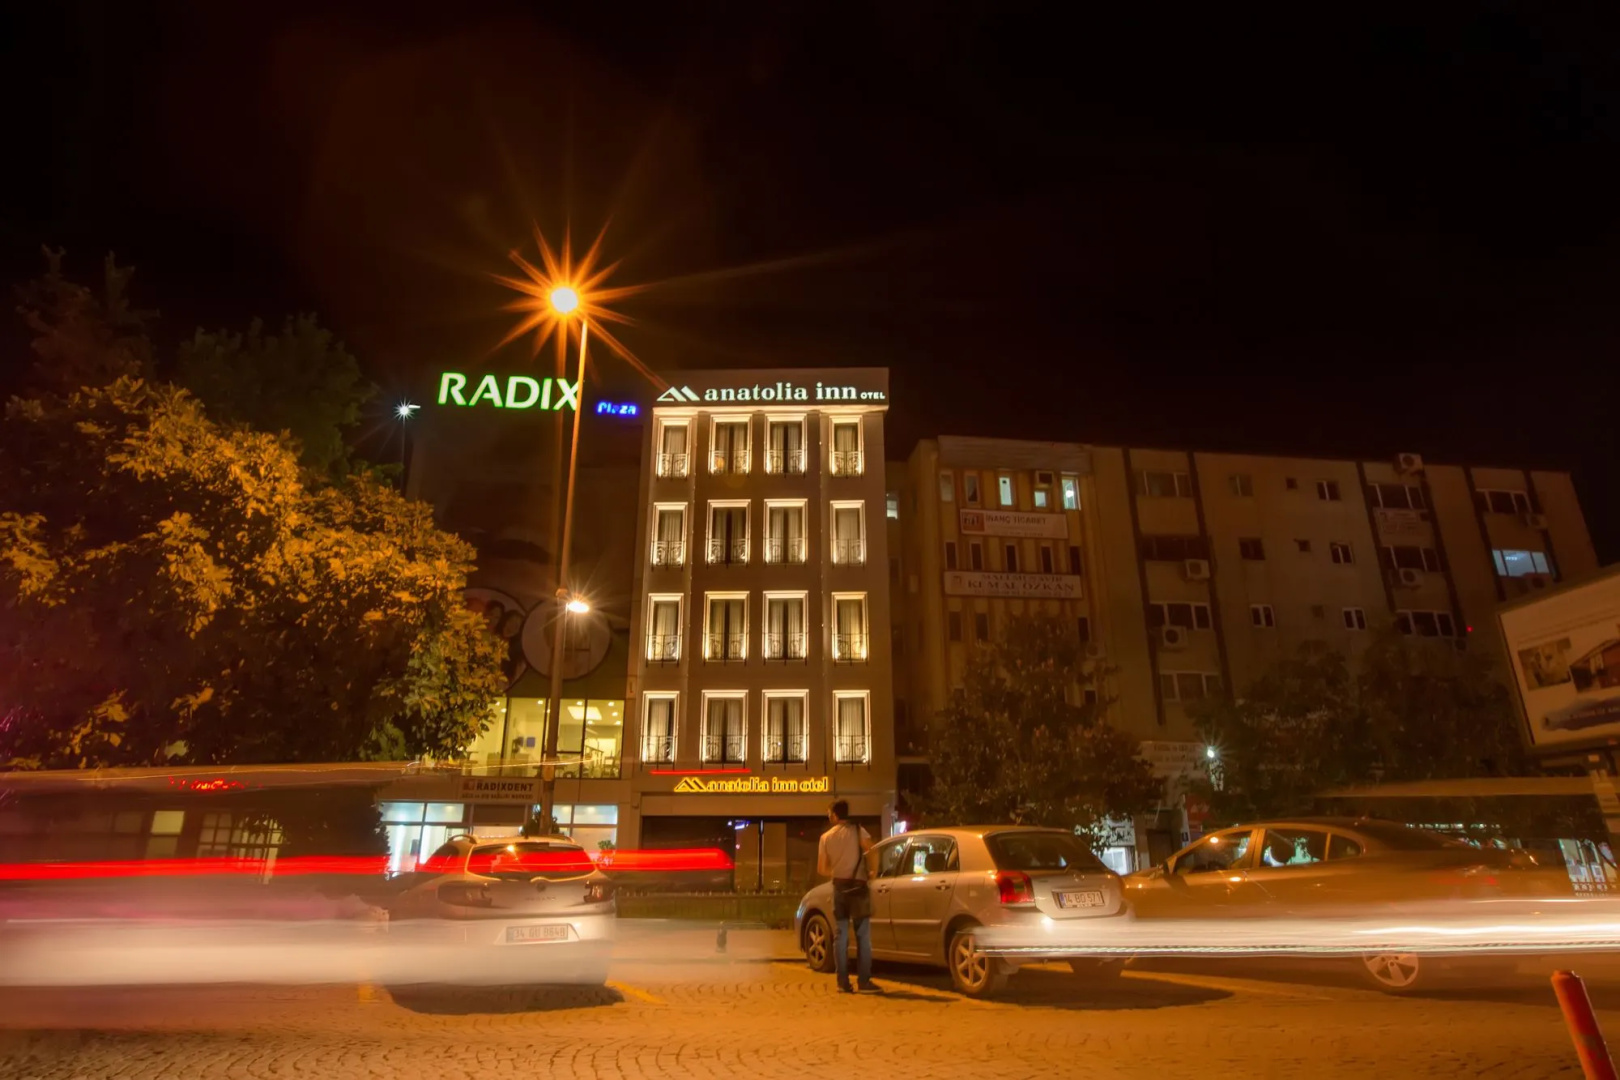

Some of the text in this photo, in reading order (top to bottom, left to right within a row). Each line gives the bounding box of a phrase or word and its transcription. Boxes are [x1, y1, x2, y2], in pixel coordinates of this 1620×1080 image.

[437, 372, 579, 411] RADIX
[704, 381, 886, 401] anatolia inn OTEL
[706, 776, 829, 792] anatolia inn otel
